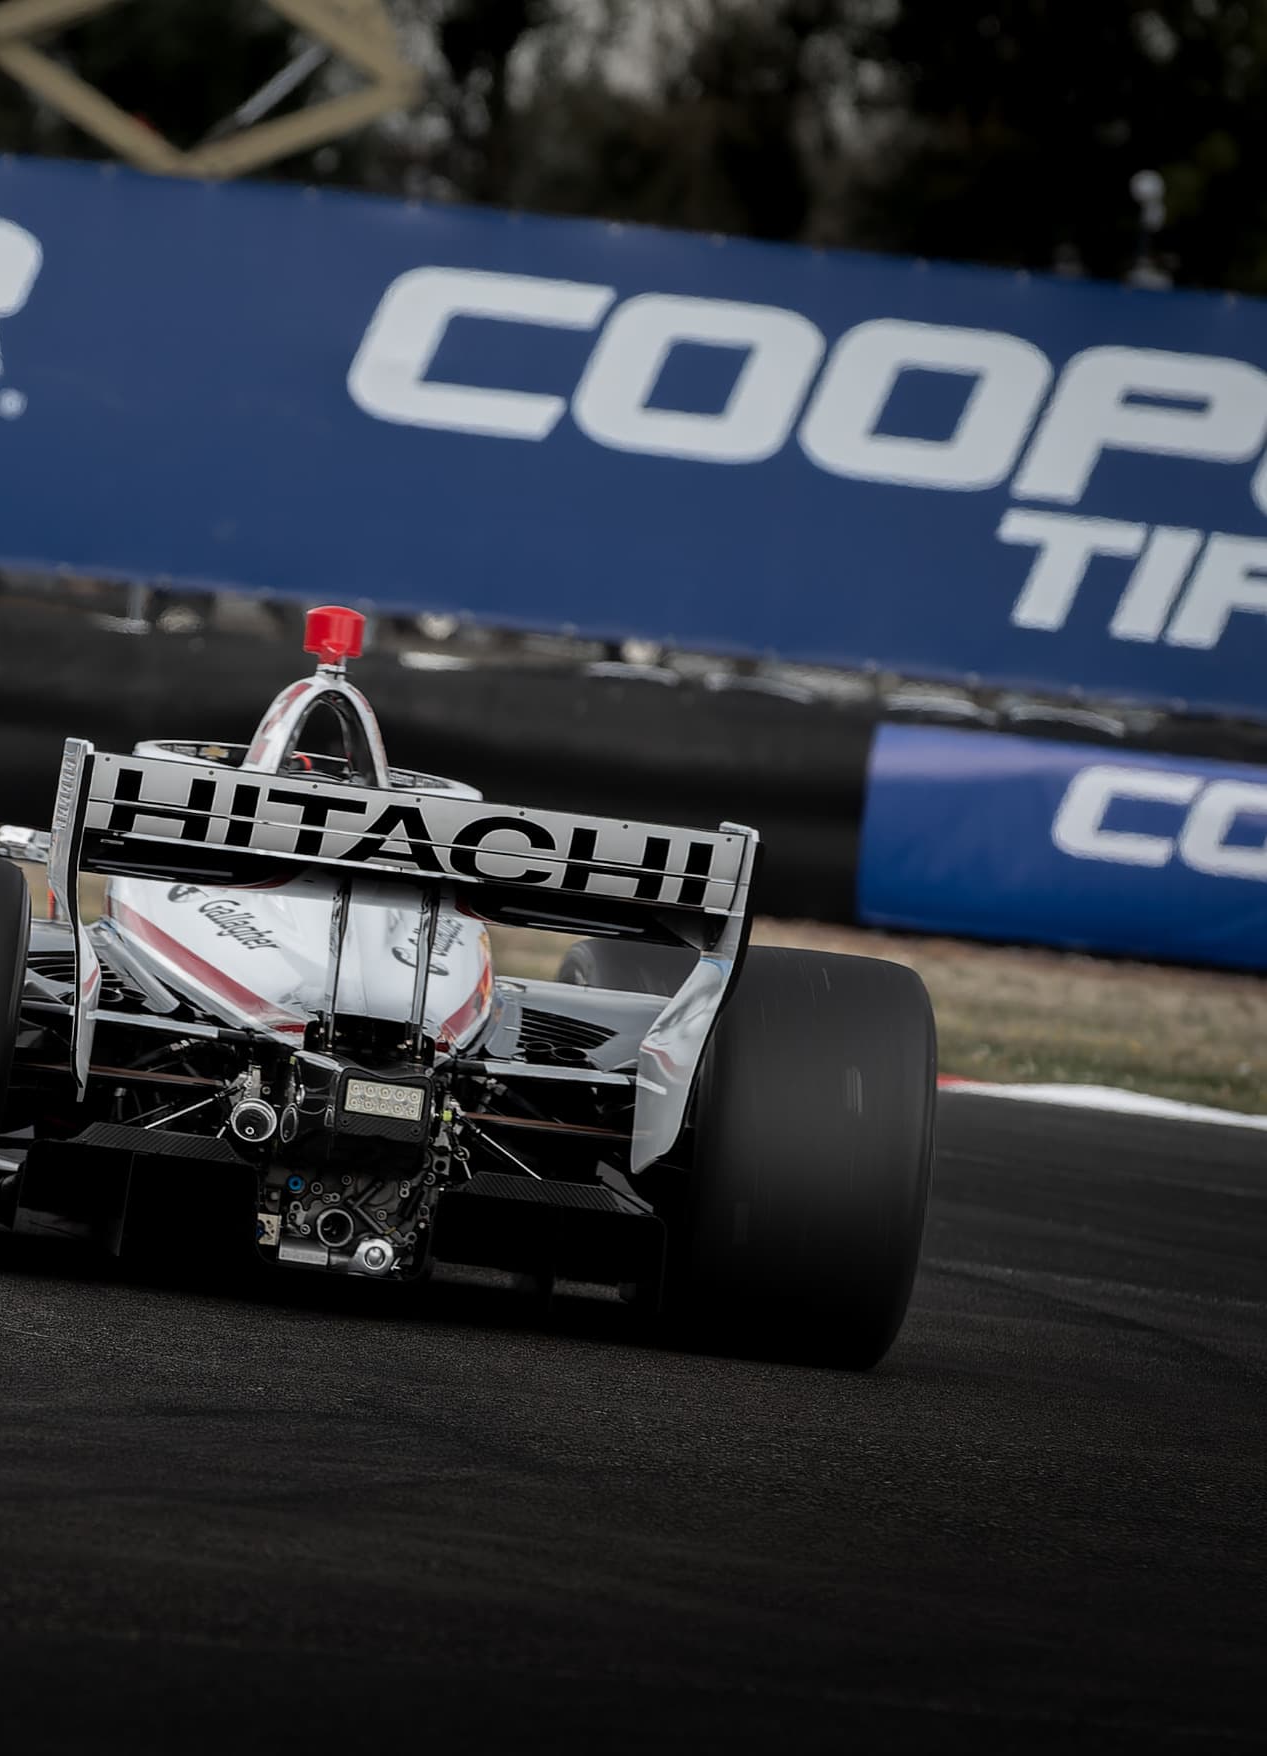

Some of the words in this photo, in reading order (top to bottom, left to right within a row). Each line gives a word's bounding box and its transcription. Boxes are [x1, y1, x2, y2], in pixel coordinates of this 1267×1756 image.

[348, 265, 1267, 516] COOP
[111, 768, 715, 906] HITACHI
[198, 899, 281, 950] Gallagher
